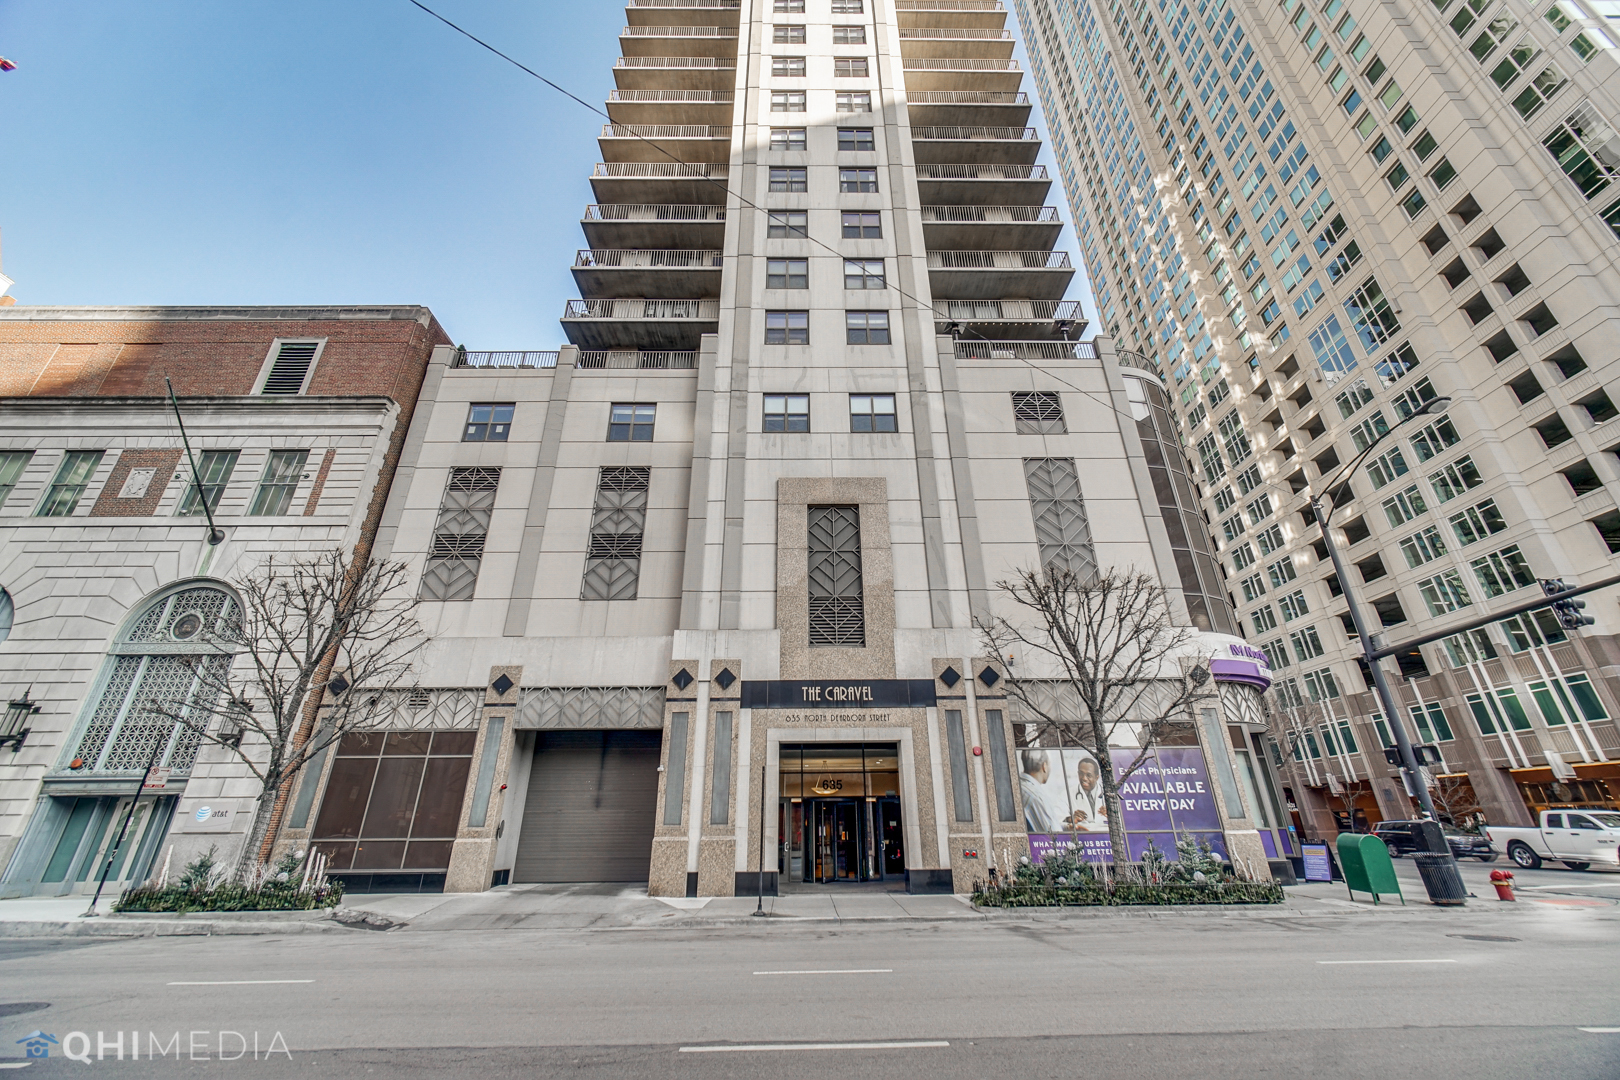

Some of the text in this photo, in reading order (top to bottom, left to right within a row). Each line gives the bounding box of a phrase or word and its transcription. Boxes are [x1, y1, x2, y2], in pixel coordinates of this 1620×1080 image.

[802, 686, 873, 701] THE CARAVEL
[785, 713, 891, 723] 635 NORTH DEARBORN STREET
[1118, 766, 1197, 777] Epert Physicians
[822, 780, 843, 790] 635
[1123, 781, 1206, 794] AVAILABLE
[1125, 798, 1195, 811] EVERY DAY
[1084, 840, 1094, 848] US
